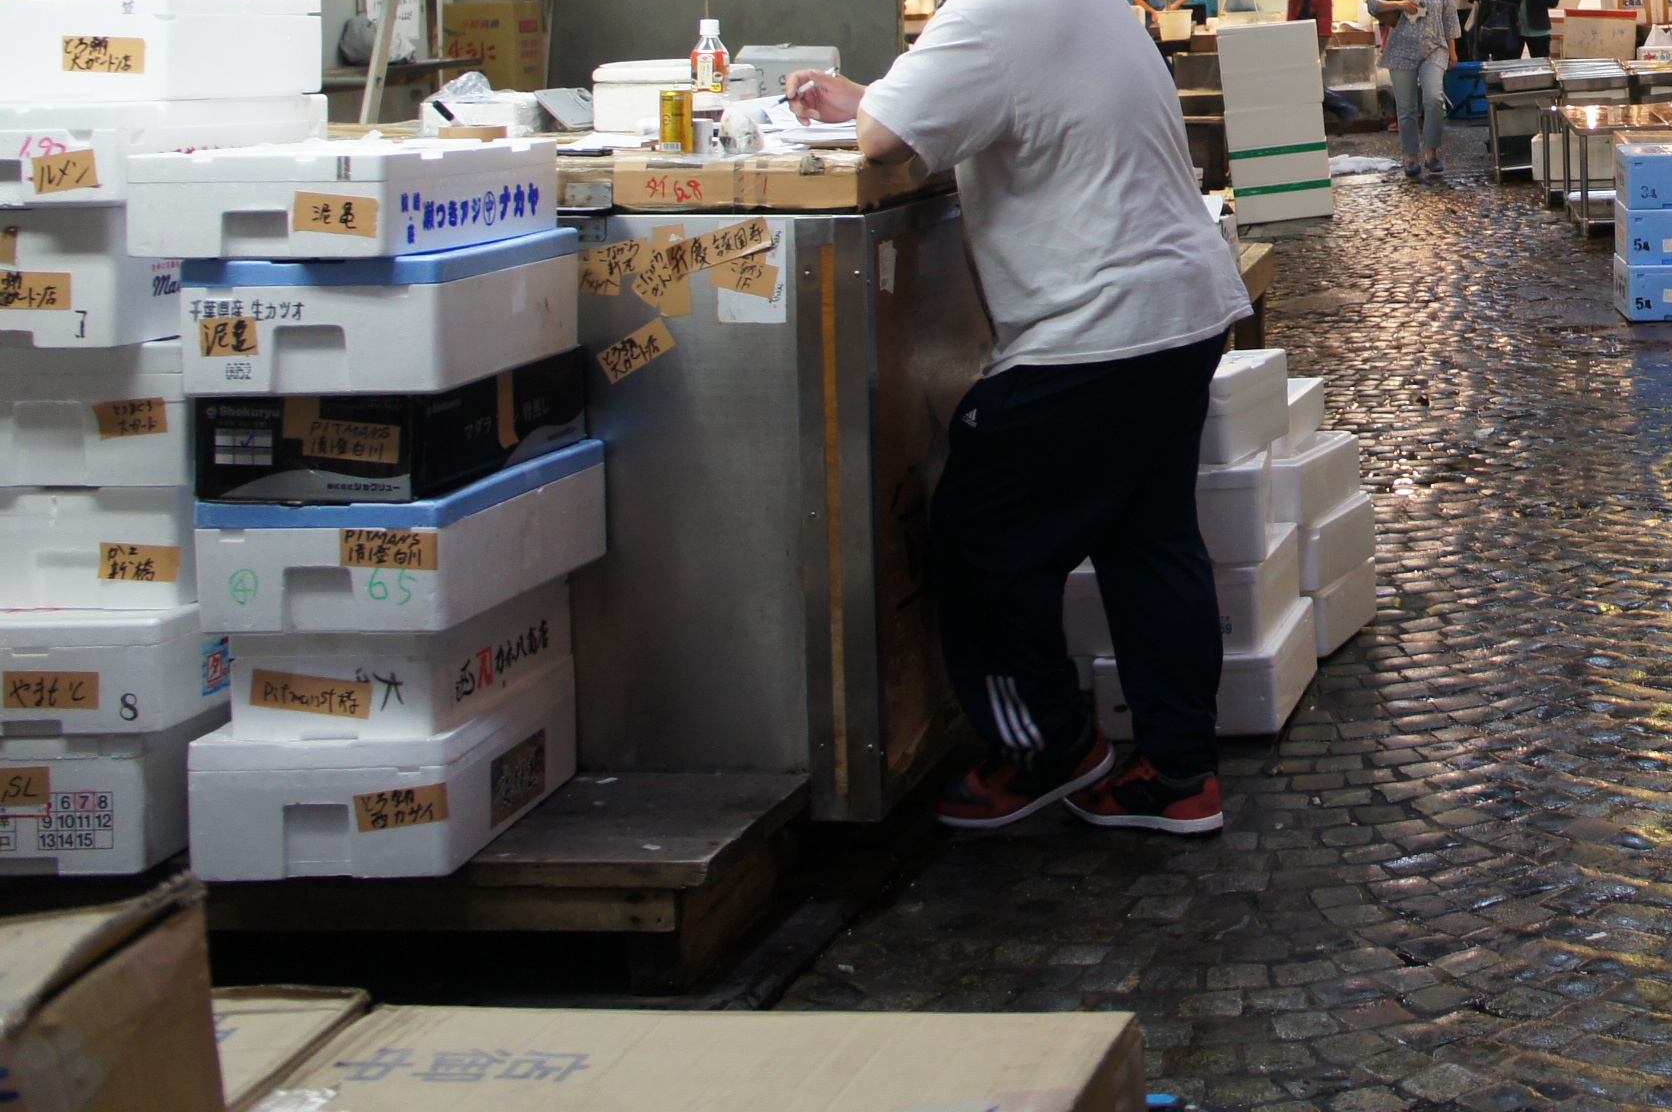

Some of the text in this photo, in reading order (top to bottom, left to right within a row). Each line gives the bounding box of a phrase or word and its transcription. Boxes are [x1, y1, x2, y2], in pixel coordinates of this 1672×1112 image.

[345, 530, 421, 546] PITMANS
[119, 693, 139, 721] 8
[61, 795, 109, 809] 6 7 8
[42, 814, 111, 829] 9 10 11 12
[41, 833, 93, 848] 13 14 15
